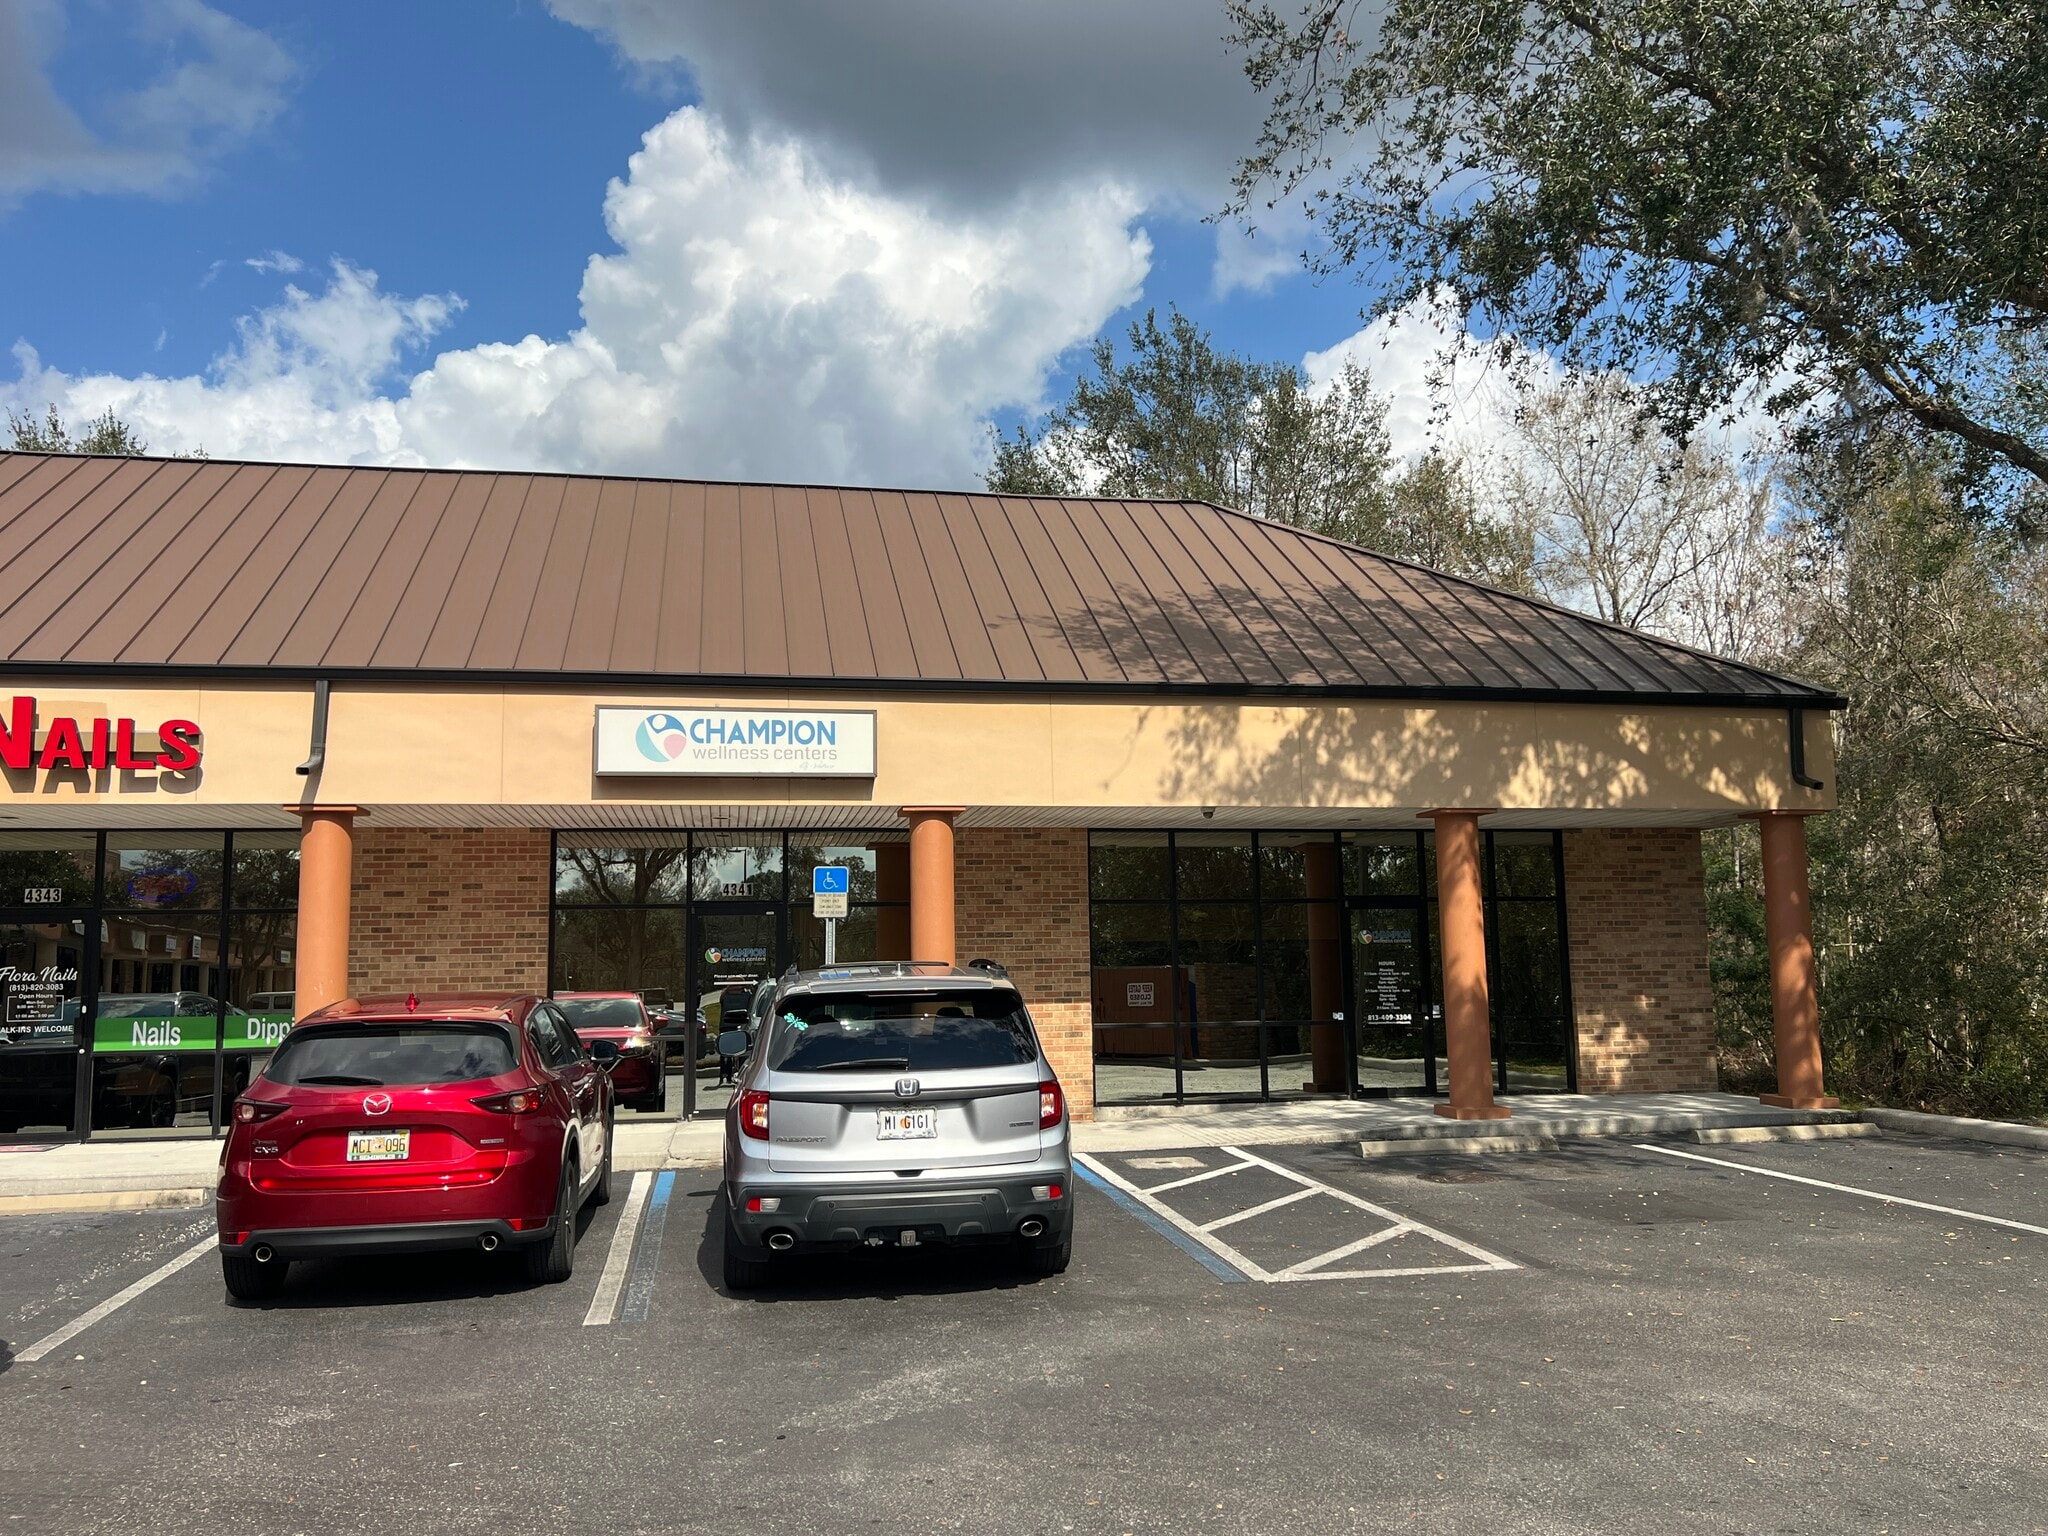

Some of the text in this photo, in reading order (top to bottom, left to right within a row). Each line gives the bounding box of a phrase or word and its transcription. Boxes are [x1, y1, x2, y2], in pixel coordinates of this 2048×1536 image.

[0, 696, 202, 770] NAILS
[690, 718, 836, 746] CHAMPION
[693, 745, 838, 761] wellness centers
[25, 888, 61, 902] 4343
[723, 884, 752, 896] 4341
[722, 948, 767, 957] CHAMPION
[0, 965, 78, 983] Flora Nails
[9, 983, 64, 992] (813)-820-3083
[34, 1025, 74, 1033] WELCOME
[132, 1021, 182, 1047] Nails
[884, 1114, 928, 1130] MI GIGI
[254, 1146, 279, 1154] CX-5
[351, 1137, 406, 1154] MCI 096
